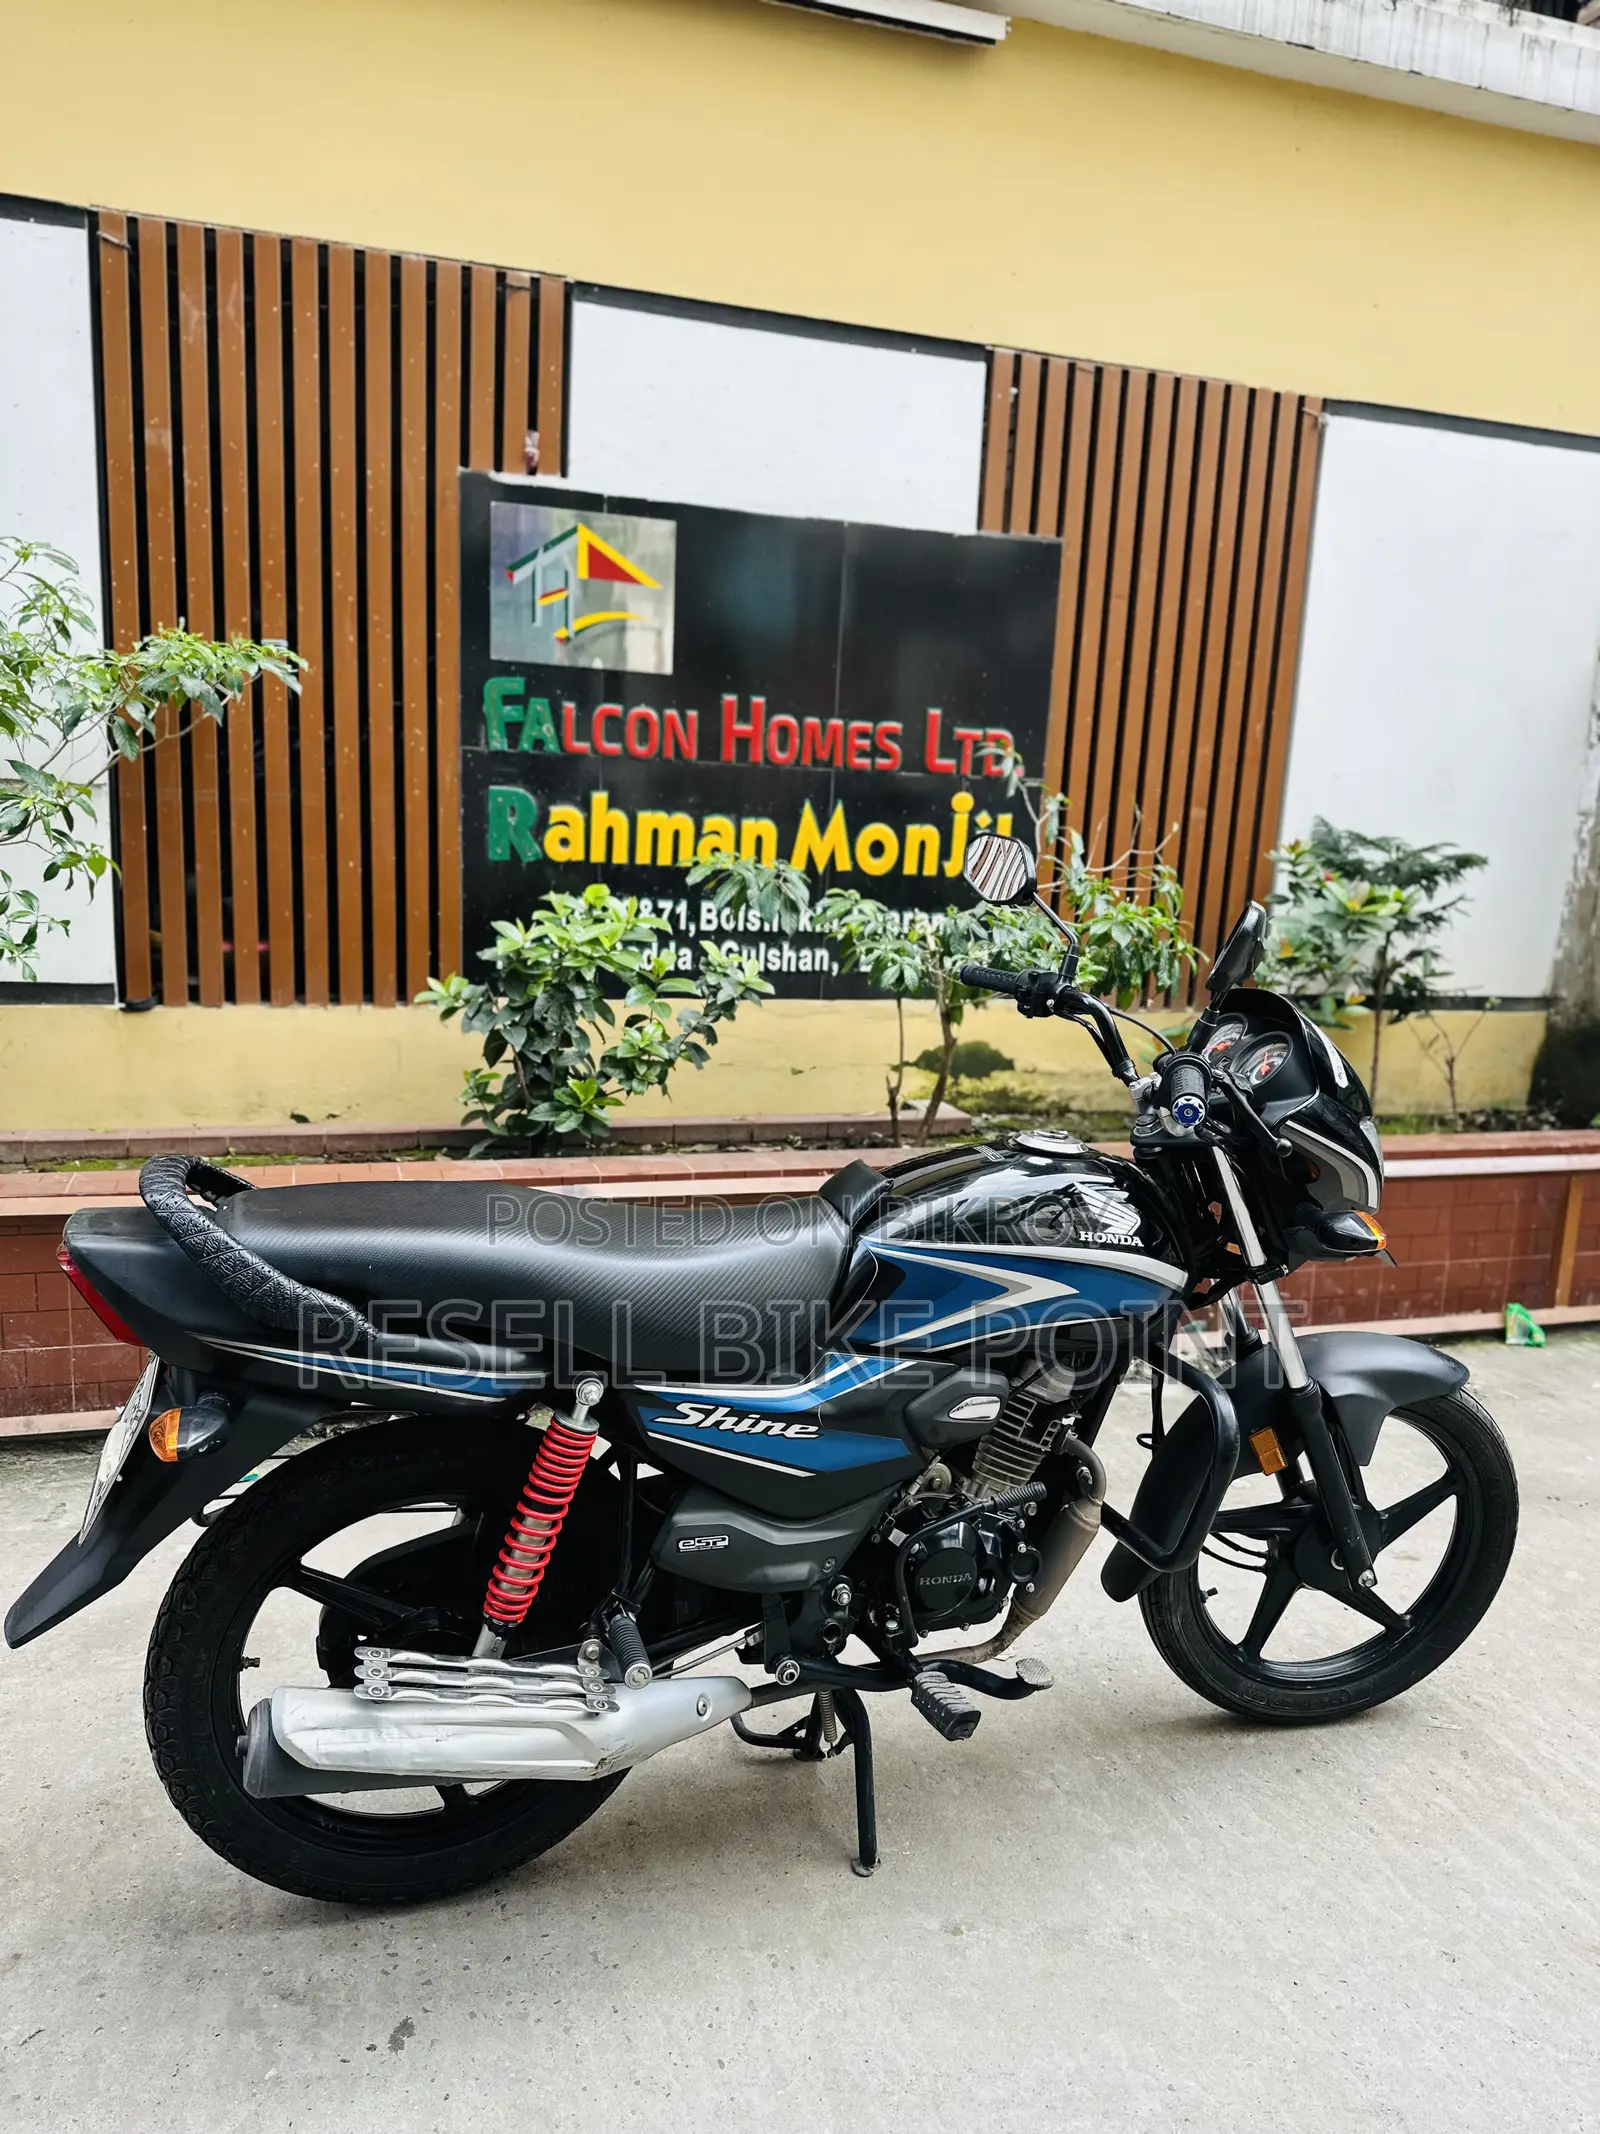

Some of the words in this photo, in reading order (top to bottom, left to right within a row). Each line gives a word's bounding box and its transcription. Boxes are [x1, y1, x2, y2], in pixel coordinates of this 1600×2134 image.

[483, 677, 699, 760] FALCON
[721, 693, 903, 771] HOMES
[487, 785, 777, 868] Rahman
[1079, 1231, 1145, 1247] HONDA
[652, 1401, 820, 1439] Shine
[919, 1573, 973, 1586] HONDA
